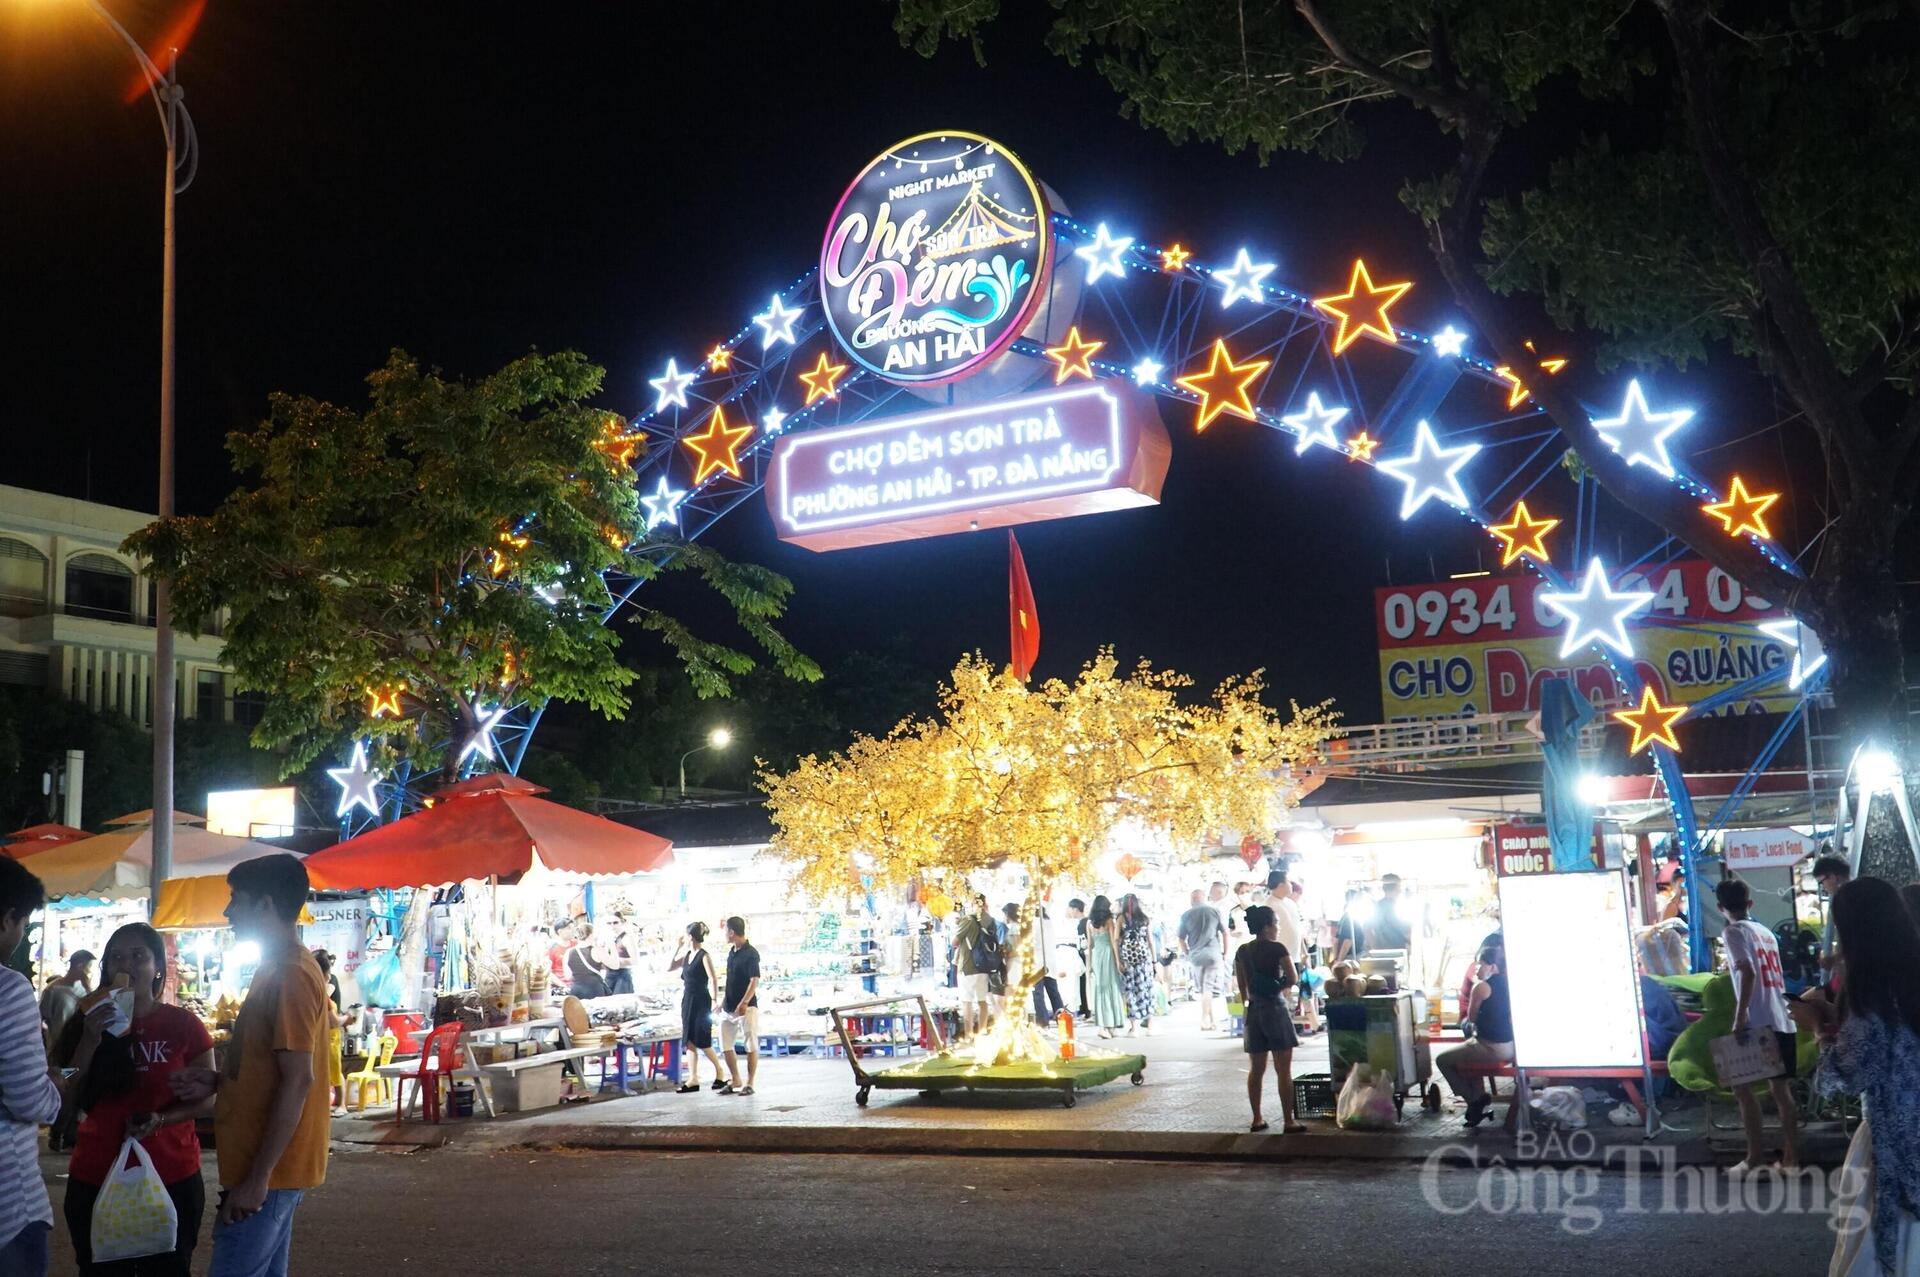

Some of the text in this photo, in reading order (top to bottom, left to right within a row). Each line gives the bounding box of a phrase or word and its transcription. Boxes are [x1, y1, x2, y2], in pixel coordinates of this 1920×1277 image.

[888, 163, 996, 200] NIGHT MARKET
[883, 339, 927, 371] AN
[828, 441, 884, 475] CHỢ
[889, 430, 943, 465] ĐÊM
[949, 423, 1004, 456] SƠN
[792, 484, 879, 517] PHƯỜNG
[882, 478, 912, 503] AN
[967, 465, 1002, 490] TP.
[1005, 453, 1039, 485] ĐÀ
[1384, 584, 1517, 640] 0934
[1388, 656, 1475, 699] CHO
[1667, 634, 1788, 684] QUẢNG
[1503, 849, 1545, 875] QUỐC
[1764, 842, 1785, 857] Local
[1786, 840, 1804, 855] Food
